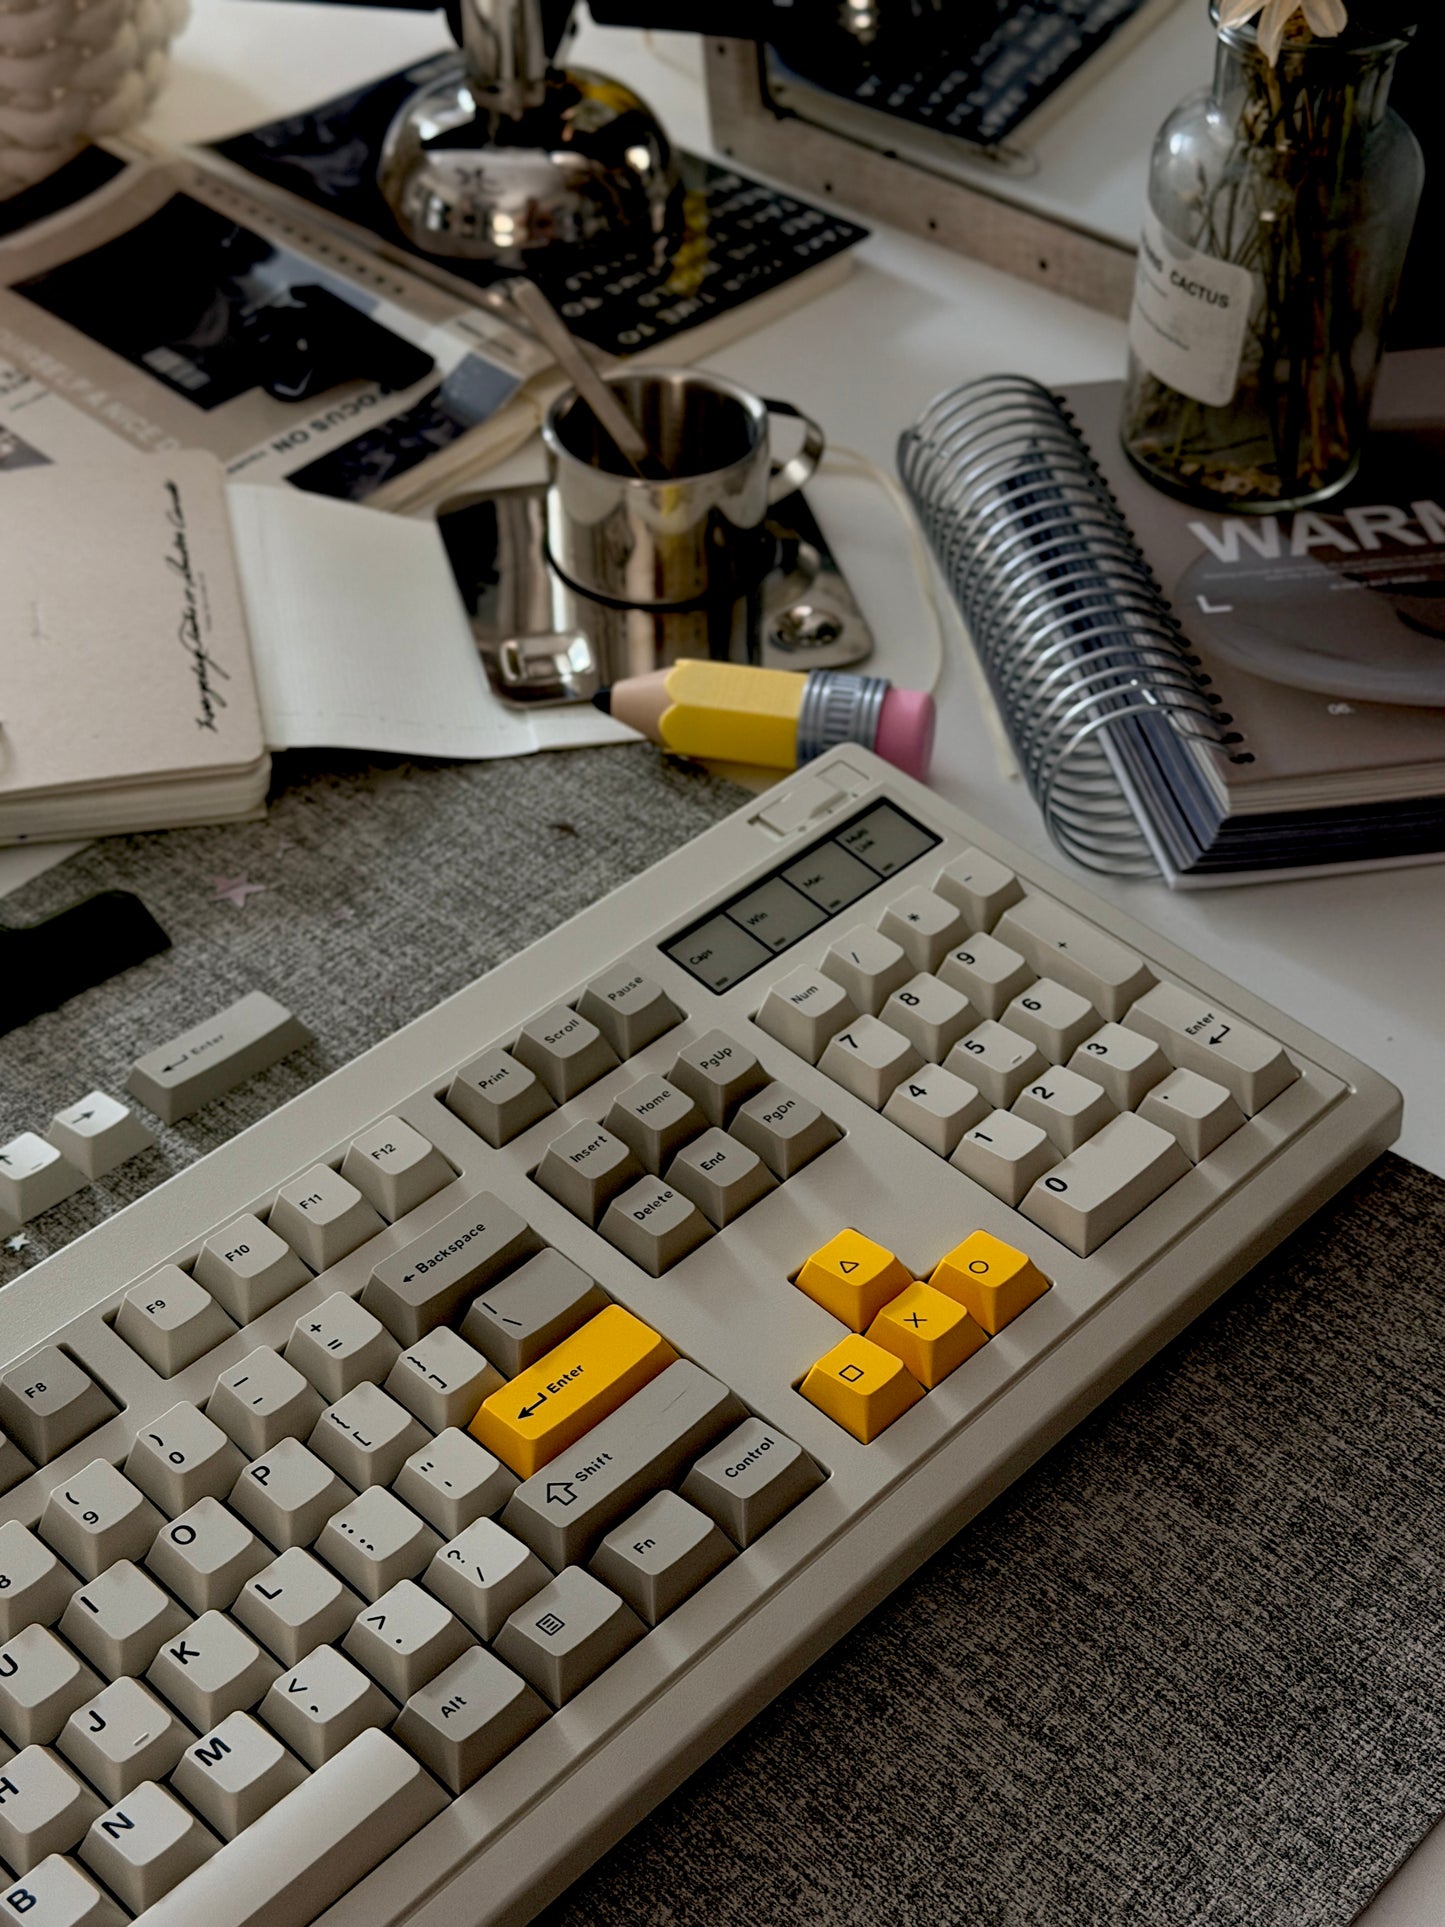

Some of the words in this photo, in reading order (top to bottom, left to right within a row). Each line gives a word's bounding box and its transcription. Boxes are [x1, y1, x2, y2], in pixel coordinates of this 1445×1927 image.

[1169, 271, 1230, 309] CACTUS
[271, 429, 310, 454] ON
[803, 874, 824, 889] Mac
[747, 910, 768, 927] Win
[689, 947, 714, 966] Caps
[956, 951, 976, 965] 9
[607, 976, 643, 1001] Pause
[790, 985, 818, 1004] Num
[899, 992, 920, 1006] 8
[1021, 998, 1042, 1011] 6
[544, 1019, 580, 1044] Scroll
[1184, 1013, 1215, 1036] Enter
[190, 1034, 224, 1055] Enter
[838, 1033, 858, 1049] 7
[964, 1040, 985, 1054] 5
[1086, 1043, 1108, 1055] 3
[699, 1047, 732, 1070] PgUp
[478, 1068, 509, 1090] Print
[908, 1084, 927, 1098] 4
[1031, 1086, 1055, 1100] 2
[635, 1090, 671, 1115] Home
[762, 1100, 796, 1123] PgDn
[974, 1131, 993, 1143] 1
[371, 1143, 396, 1160] F12
[569, 1135, 608, 1163] Insert
[700, 1151, 726, 1171] End
[1044, 1177, 1068, 1193] 0
[299, 1193, 323, 1210] F11
[633, 1191, 674, 1221] Delete
[224, 1244, 250, 1262] F10
[415, 1223, 490, 1279] Backspace
[145, 1299, 166, 1314] F9
[546, 1364, 584, 1394] Enter
[24, 1382, 47, 1399] F8
[168, 1451, 185, 1465] 0
[575, 1452, 613, 1482] Shift
[725, 1437, 775, 1478] Control
[250, 1465, 271, 1487] P
[82, 1511, 99, 1525] 9
[170, 1524, 197, 1546] O
[632, 1539, 656, 1555] Fn
[254, 1583, 283, 1600] L
[80, 1596, 100, 1614] I
[169, 1640, 201, 1665] K
[441, 1696, 467, 1719] Alt
[88, 1710, 107, 1733] J
[194, 1737, 232, 1766] M
[101, 1811, 135, 1839] N
[6, 1888, 37, 1914] B
